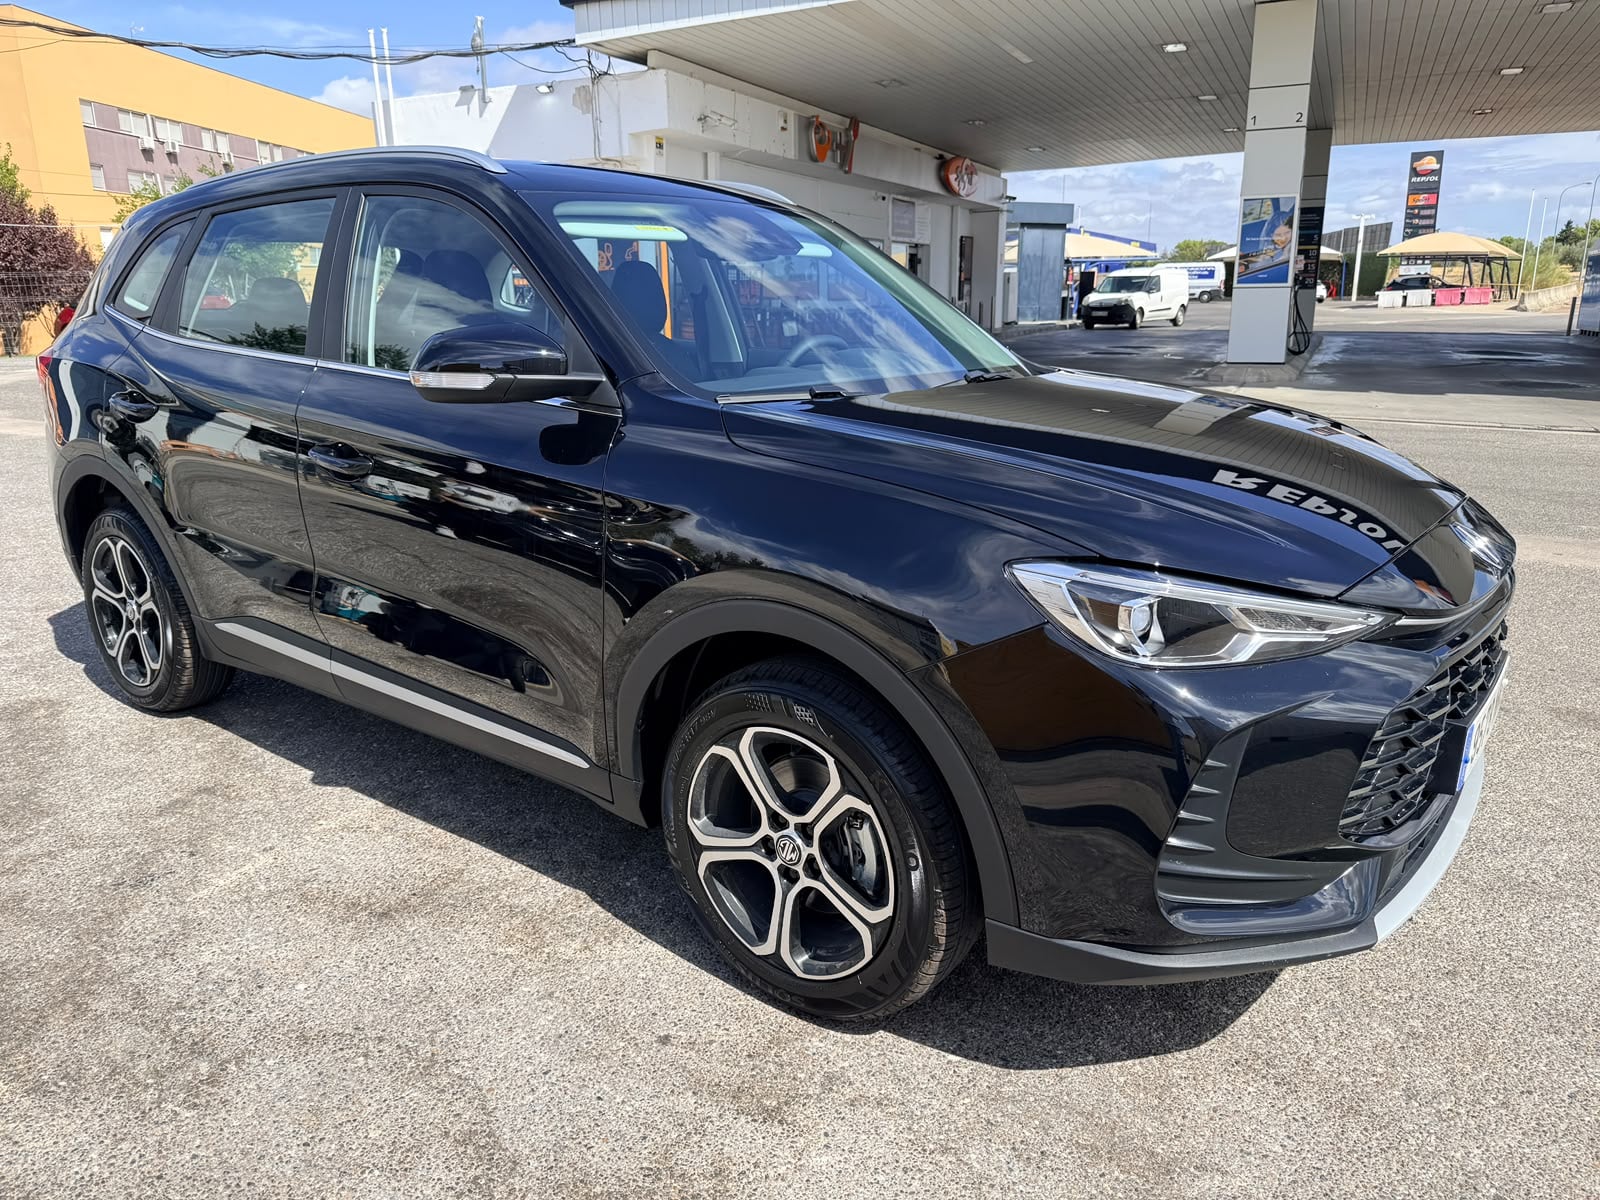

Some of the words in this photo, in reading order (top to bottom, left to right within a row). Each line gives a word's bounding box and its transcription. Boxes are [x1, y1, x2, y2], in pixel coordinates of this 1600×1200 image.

[1251, 115, 1256, 126] 1
[1295, 111, 1303, 123] 2
[1411, 175, 1439, 183] REPSOL
[779, 839, 798, 862] MG
